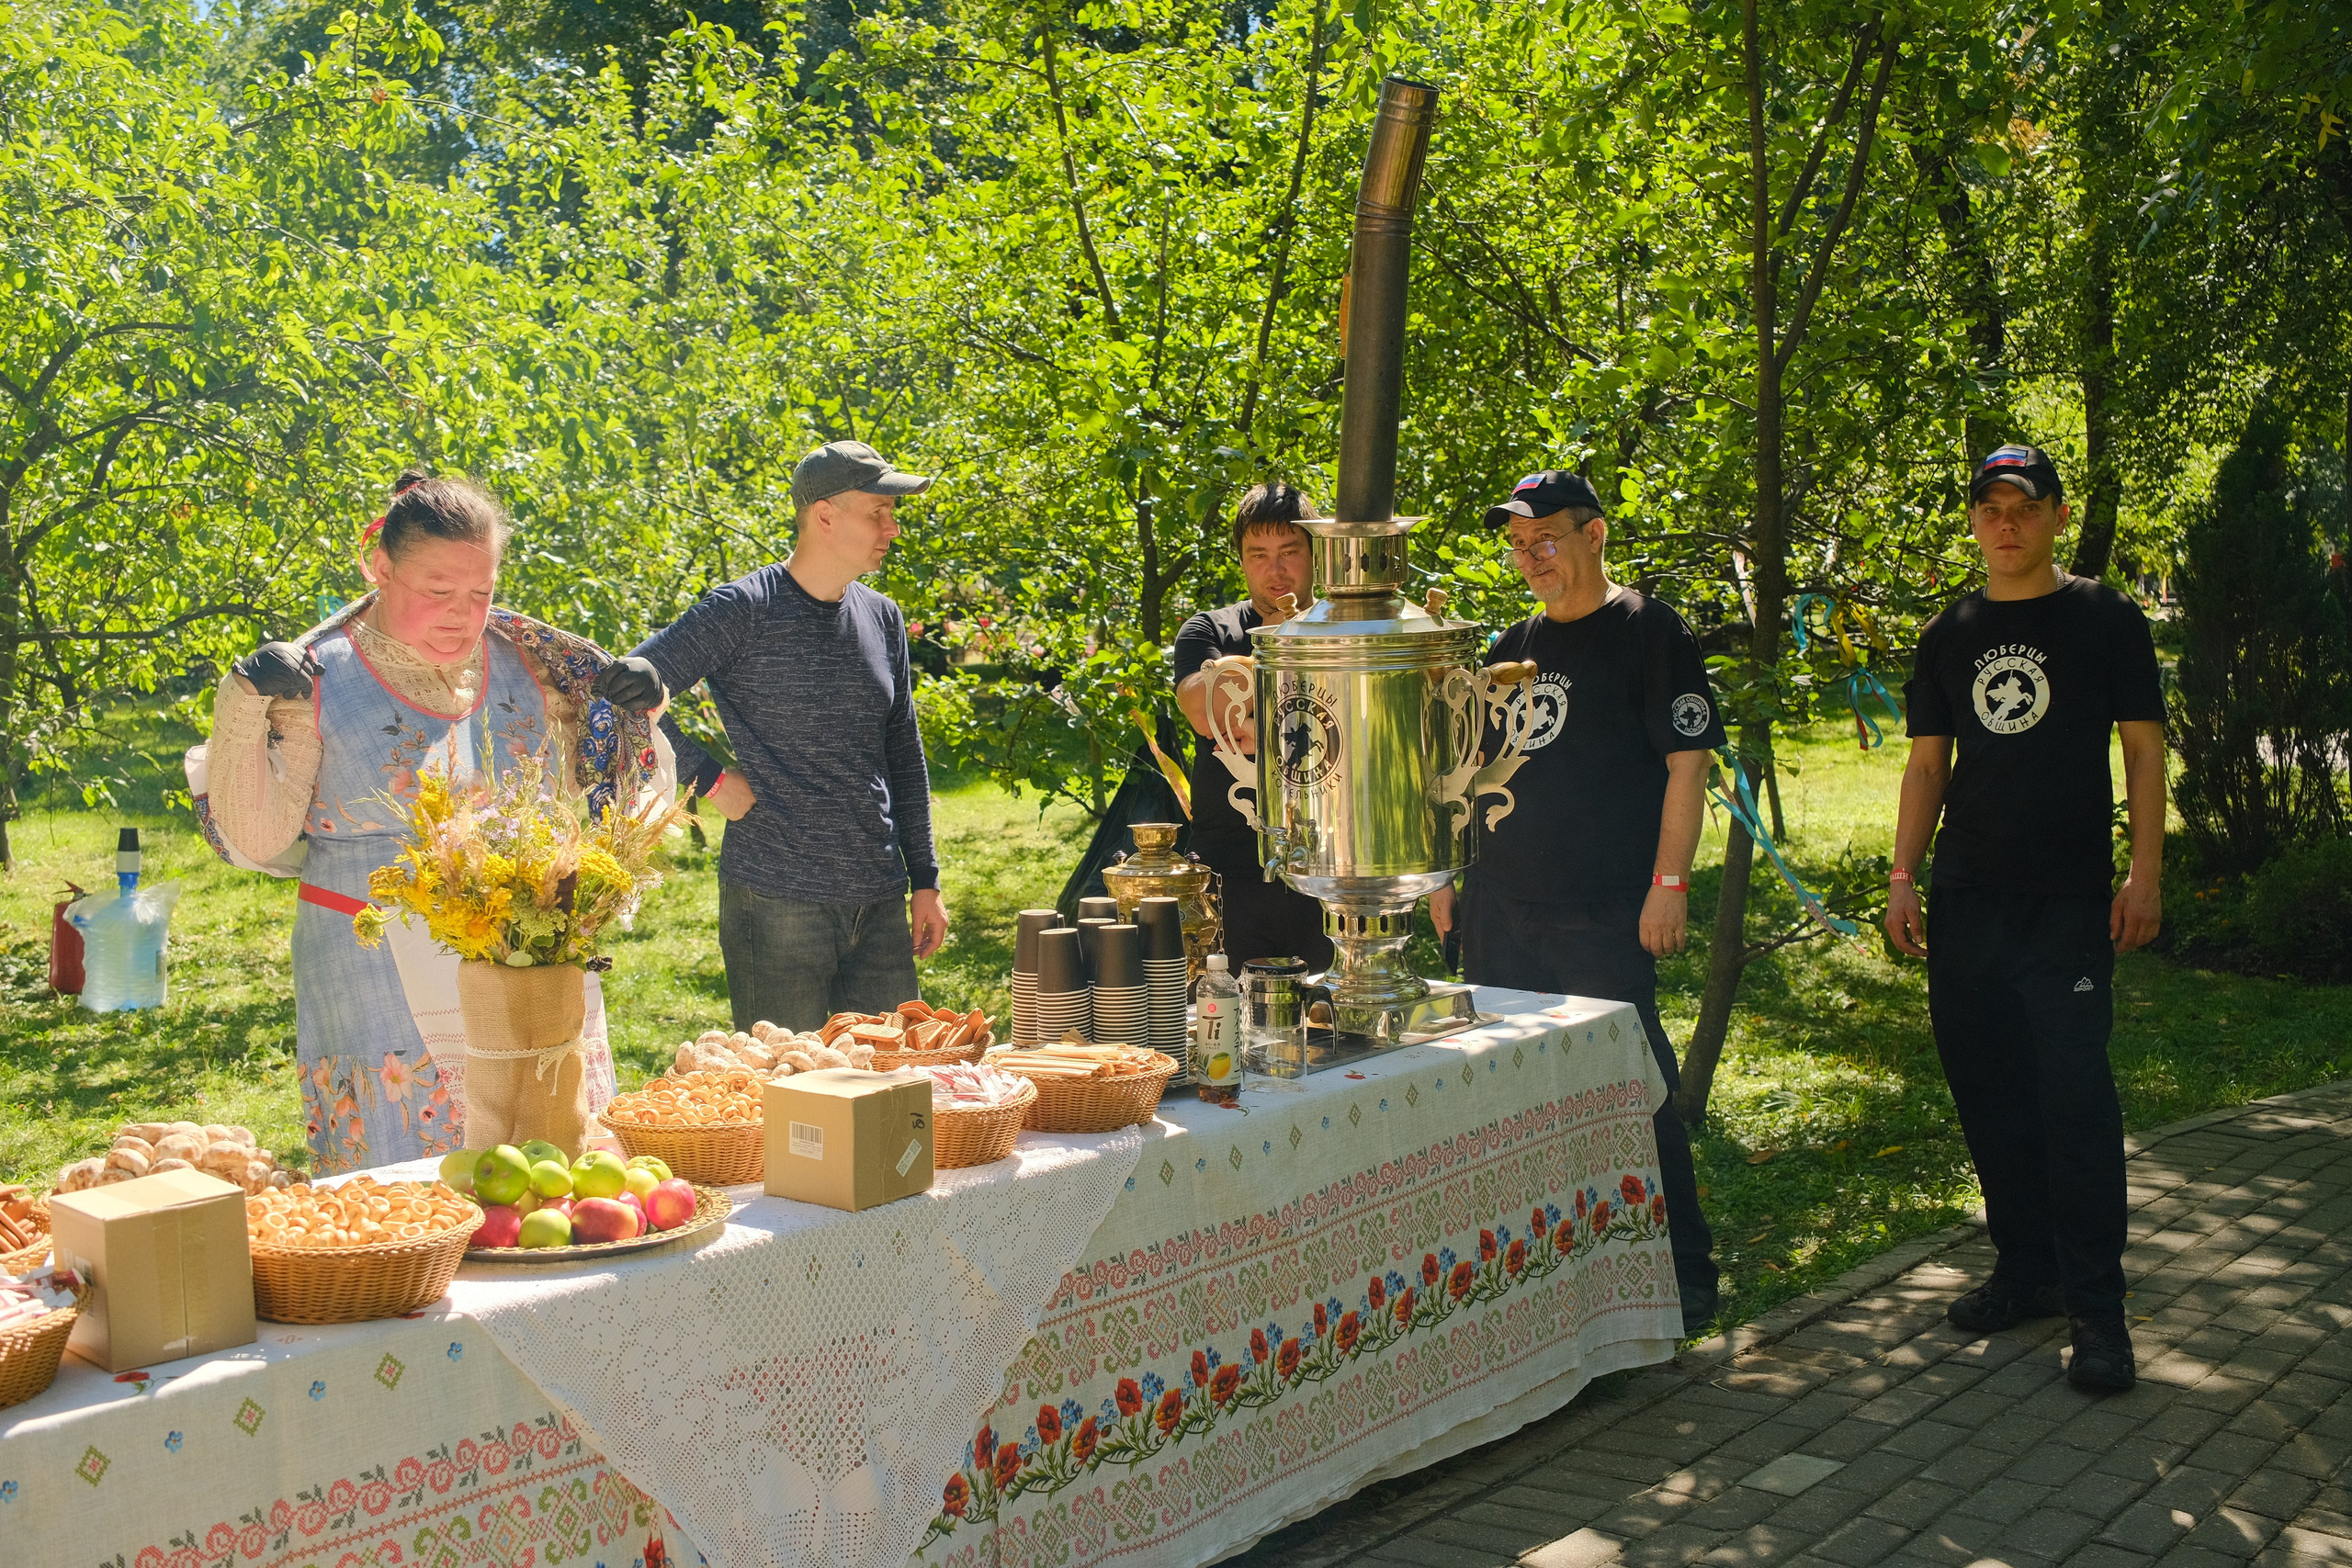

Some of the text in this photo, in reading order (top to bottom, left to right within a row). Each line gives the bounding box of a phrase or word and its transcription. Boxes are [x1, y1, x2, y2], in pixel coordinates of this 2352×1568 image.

[1973, 643, 2048, 671] ЛЮБЕРЦЫ
[1977, 658, 2045, 685] РУССКАЯ
[1272, 680, 1338, 706] ЛЮБЕРЦЫ
[1516, 684, 1567, 707] РССКАЯ
[1273, 698, 1336, 729] РУССКАЯ
[1981, 711, 2040, 732] ОБЩИНА
[1510, 728, 1555, 749] БИНА
[1275, 755, 1333, 784] ОБЩИНА
[1271, 770, 1343, 799] КОТЕЛЬНИКИ
[1202, 1015, 1224, 1041] Ti
